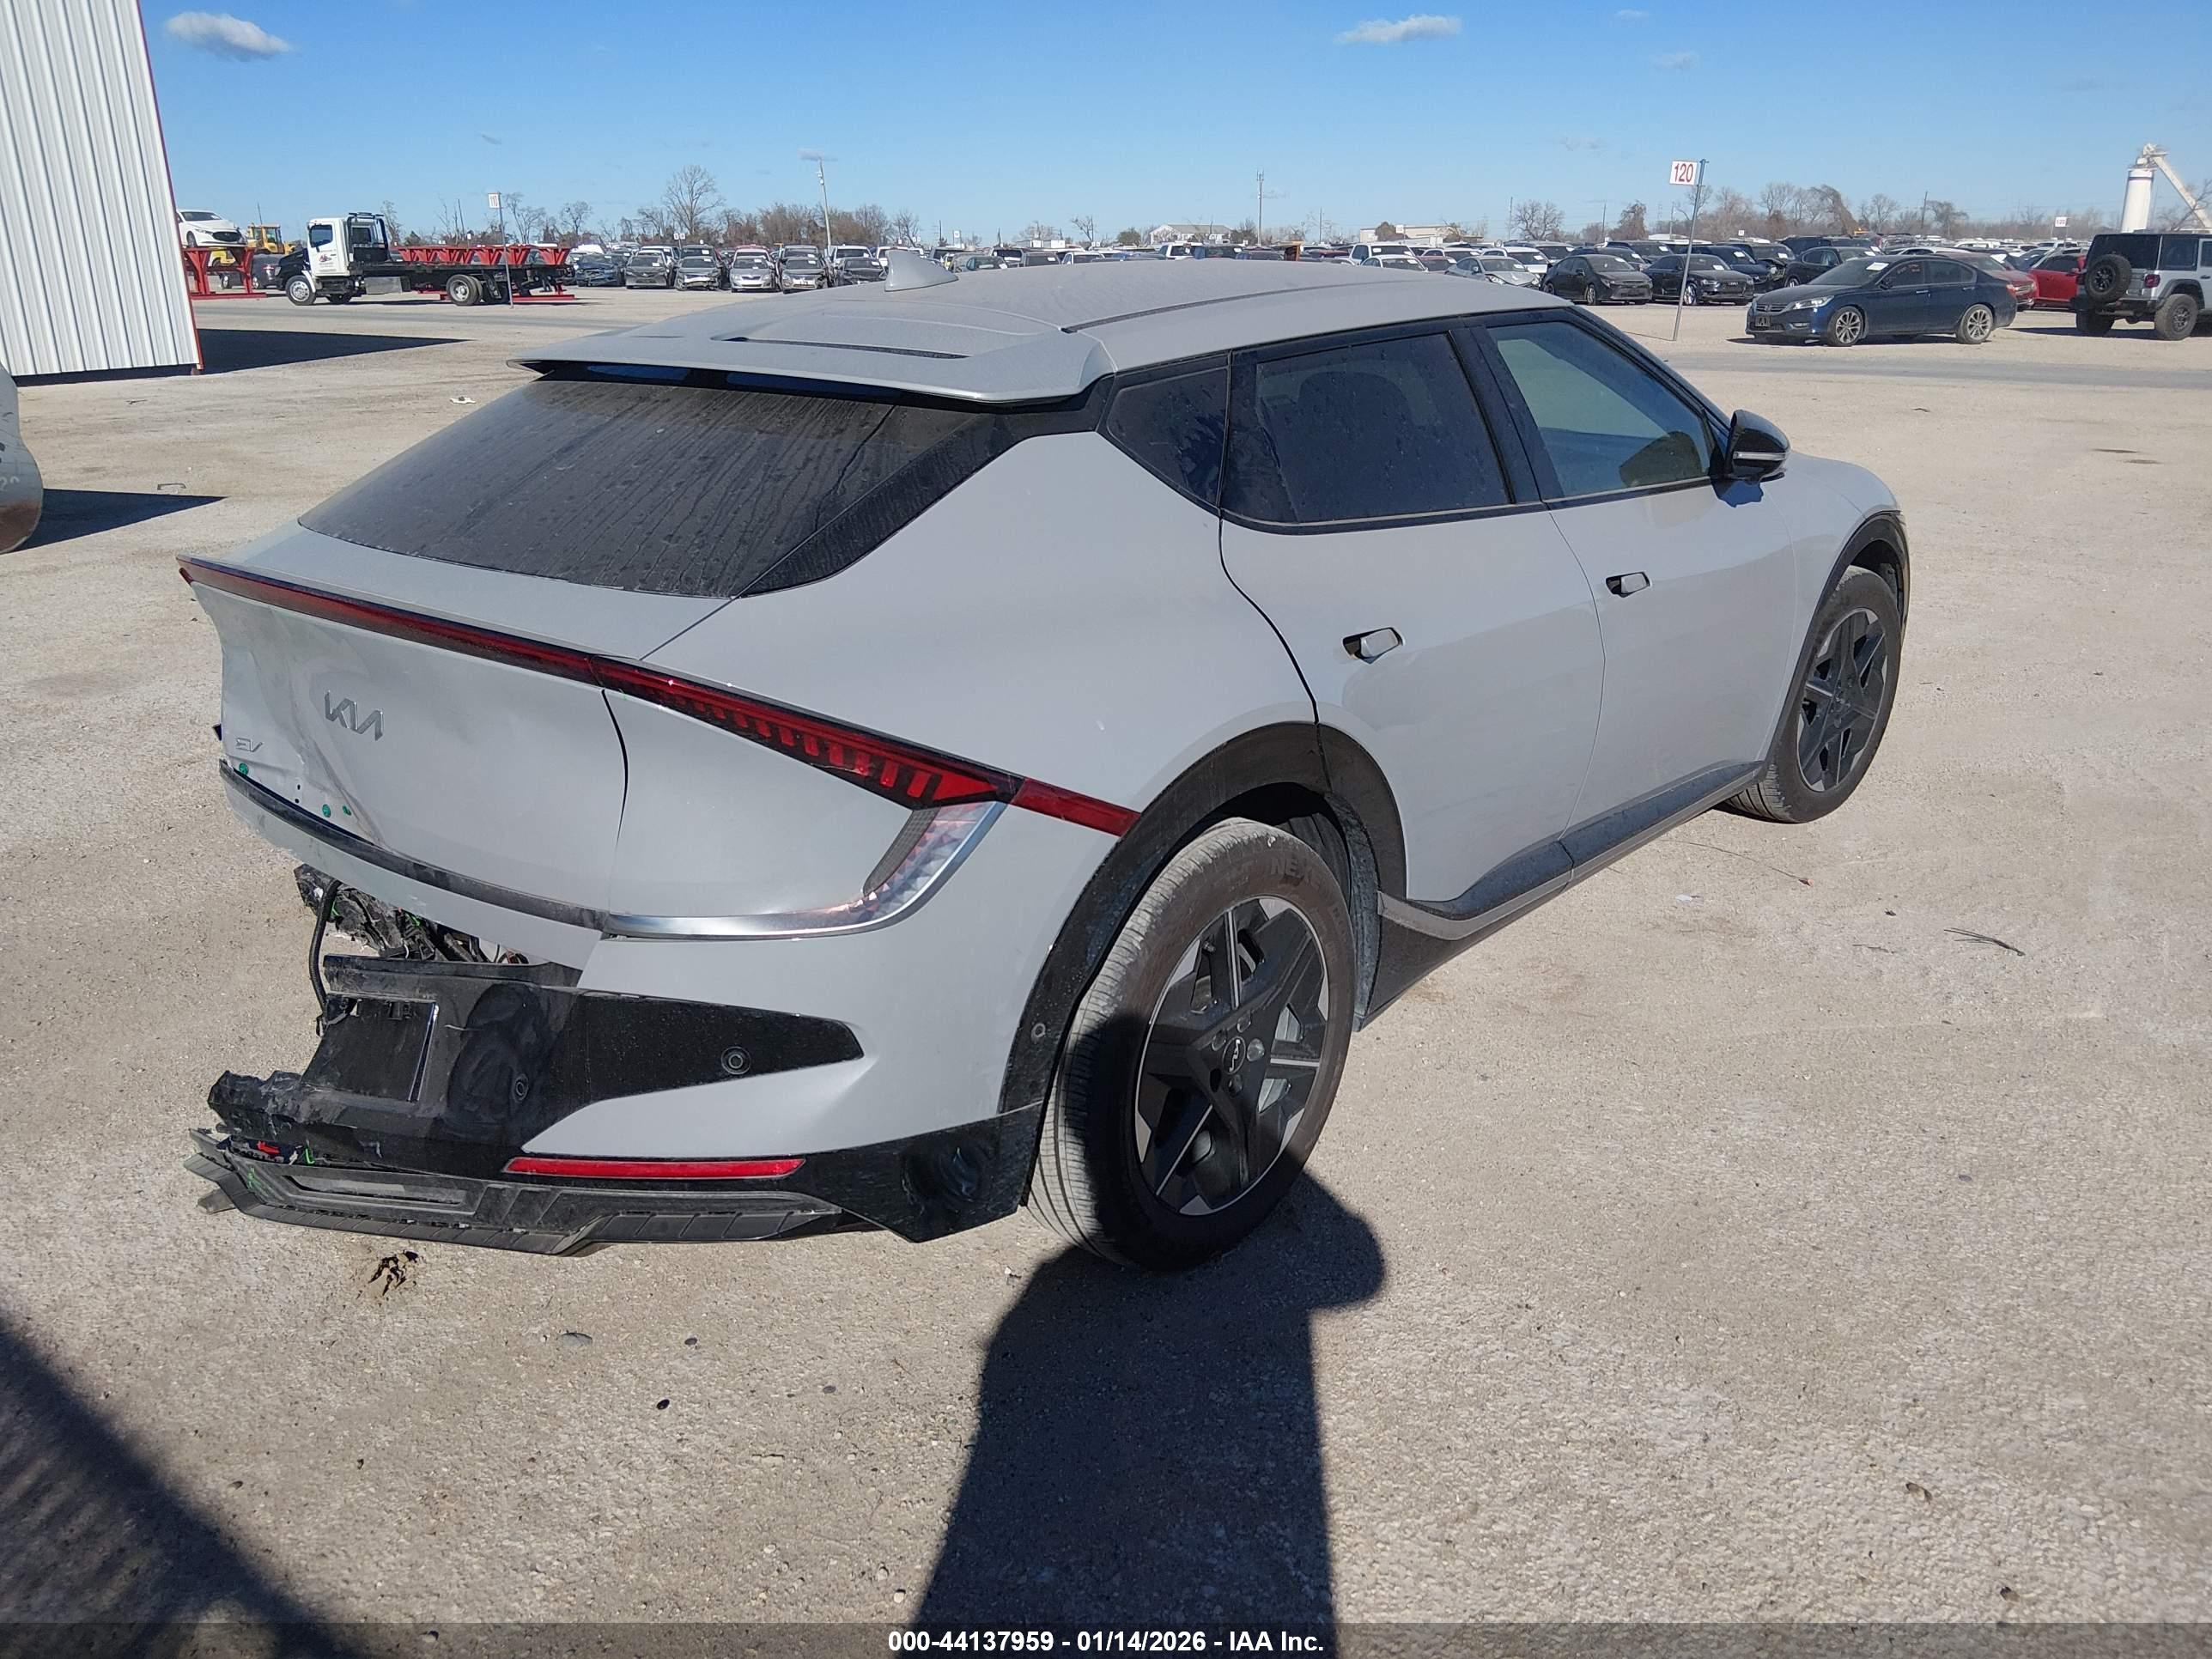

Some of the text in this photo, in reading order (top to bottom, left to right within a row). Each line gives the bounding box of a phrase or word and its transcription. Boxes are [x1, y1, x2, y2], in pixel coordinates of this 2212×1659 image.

[1674, 163, 1694, 183] 120
[325, 690, 385, 742] KIA
[235, 737, 264, 753] EV
